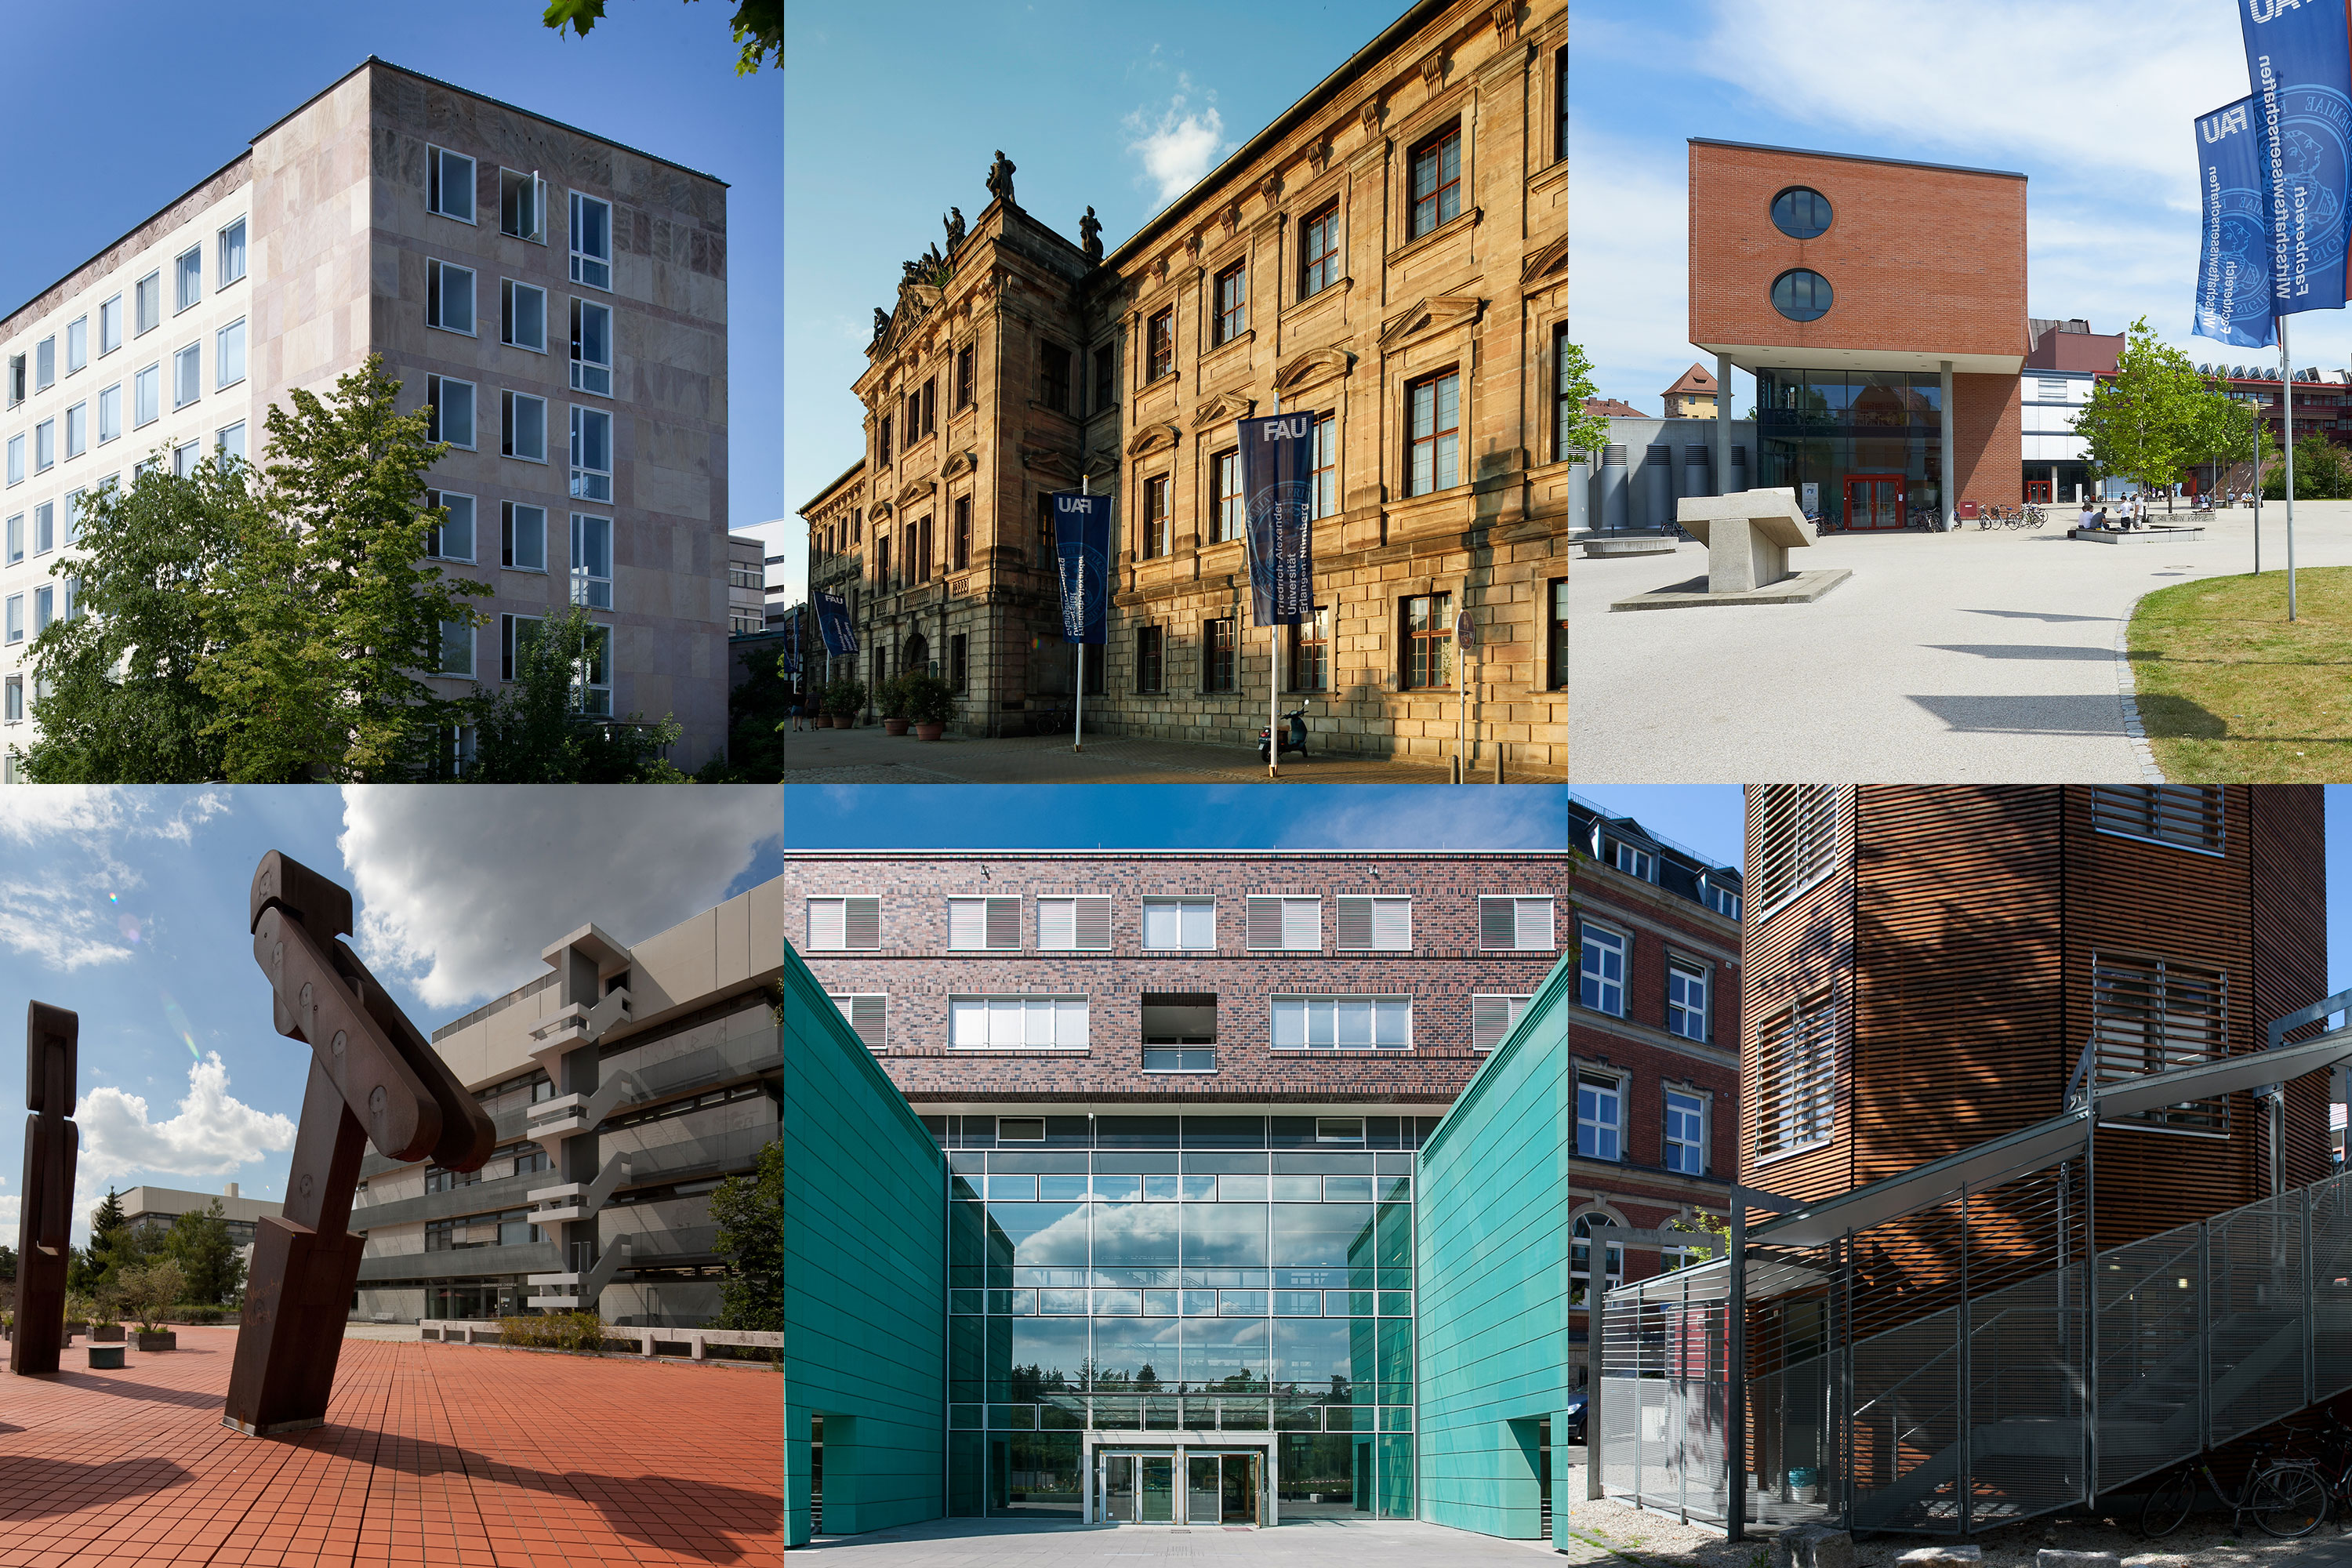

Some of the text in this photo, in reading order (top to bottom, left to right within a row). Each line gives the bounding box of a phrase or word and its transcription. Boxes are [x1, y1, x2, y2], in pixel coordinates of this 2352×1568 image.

[1264, 417, 1307, 441] FAU
[1273, 501, 1284, 615] Friedrich-Alexander
[1287, 553, 1297, 615] Universität
[1299, 503, 1309, 614] Erlangen-Nürnberg
[825, 594, 843, 604] FAU
